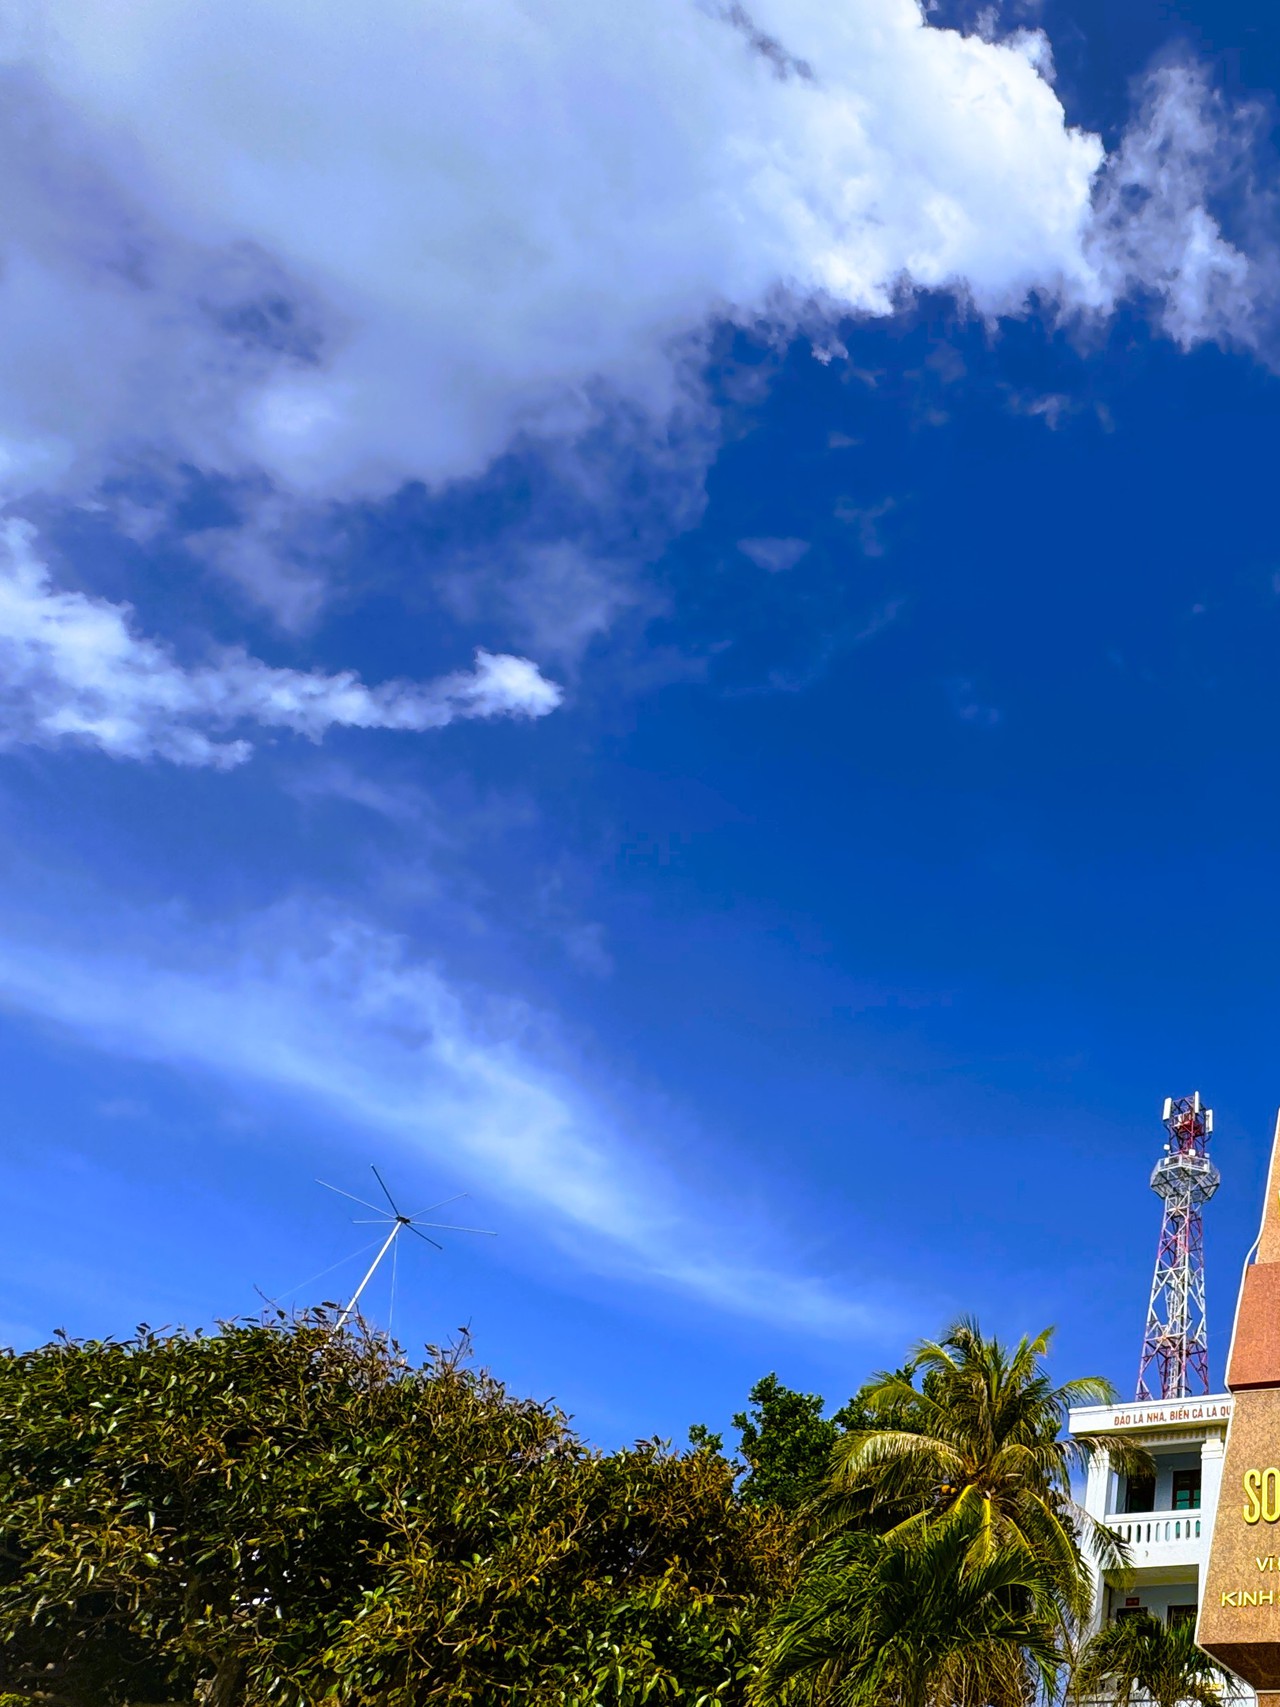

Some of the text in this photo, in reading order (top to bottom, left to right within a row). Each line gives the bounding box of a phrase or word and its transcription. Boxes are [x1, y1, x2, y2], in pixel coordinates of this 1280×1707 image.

[1113, 1411, 1131, 1426] ĐẢO
[1133, 1411, 1144, 1424] LÀ
[1169, 1406, 1190, 1421] BIỂN
[1192, 1404, 1203, 1419] CẢ
[1206, 1404, 1217, 1417] LÀ
[1256, 1554, 1275, 1572] VĨ
[1221, 1590, 1274, 1607] KINH
